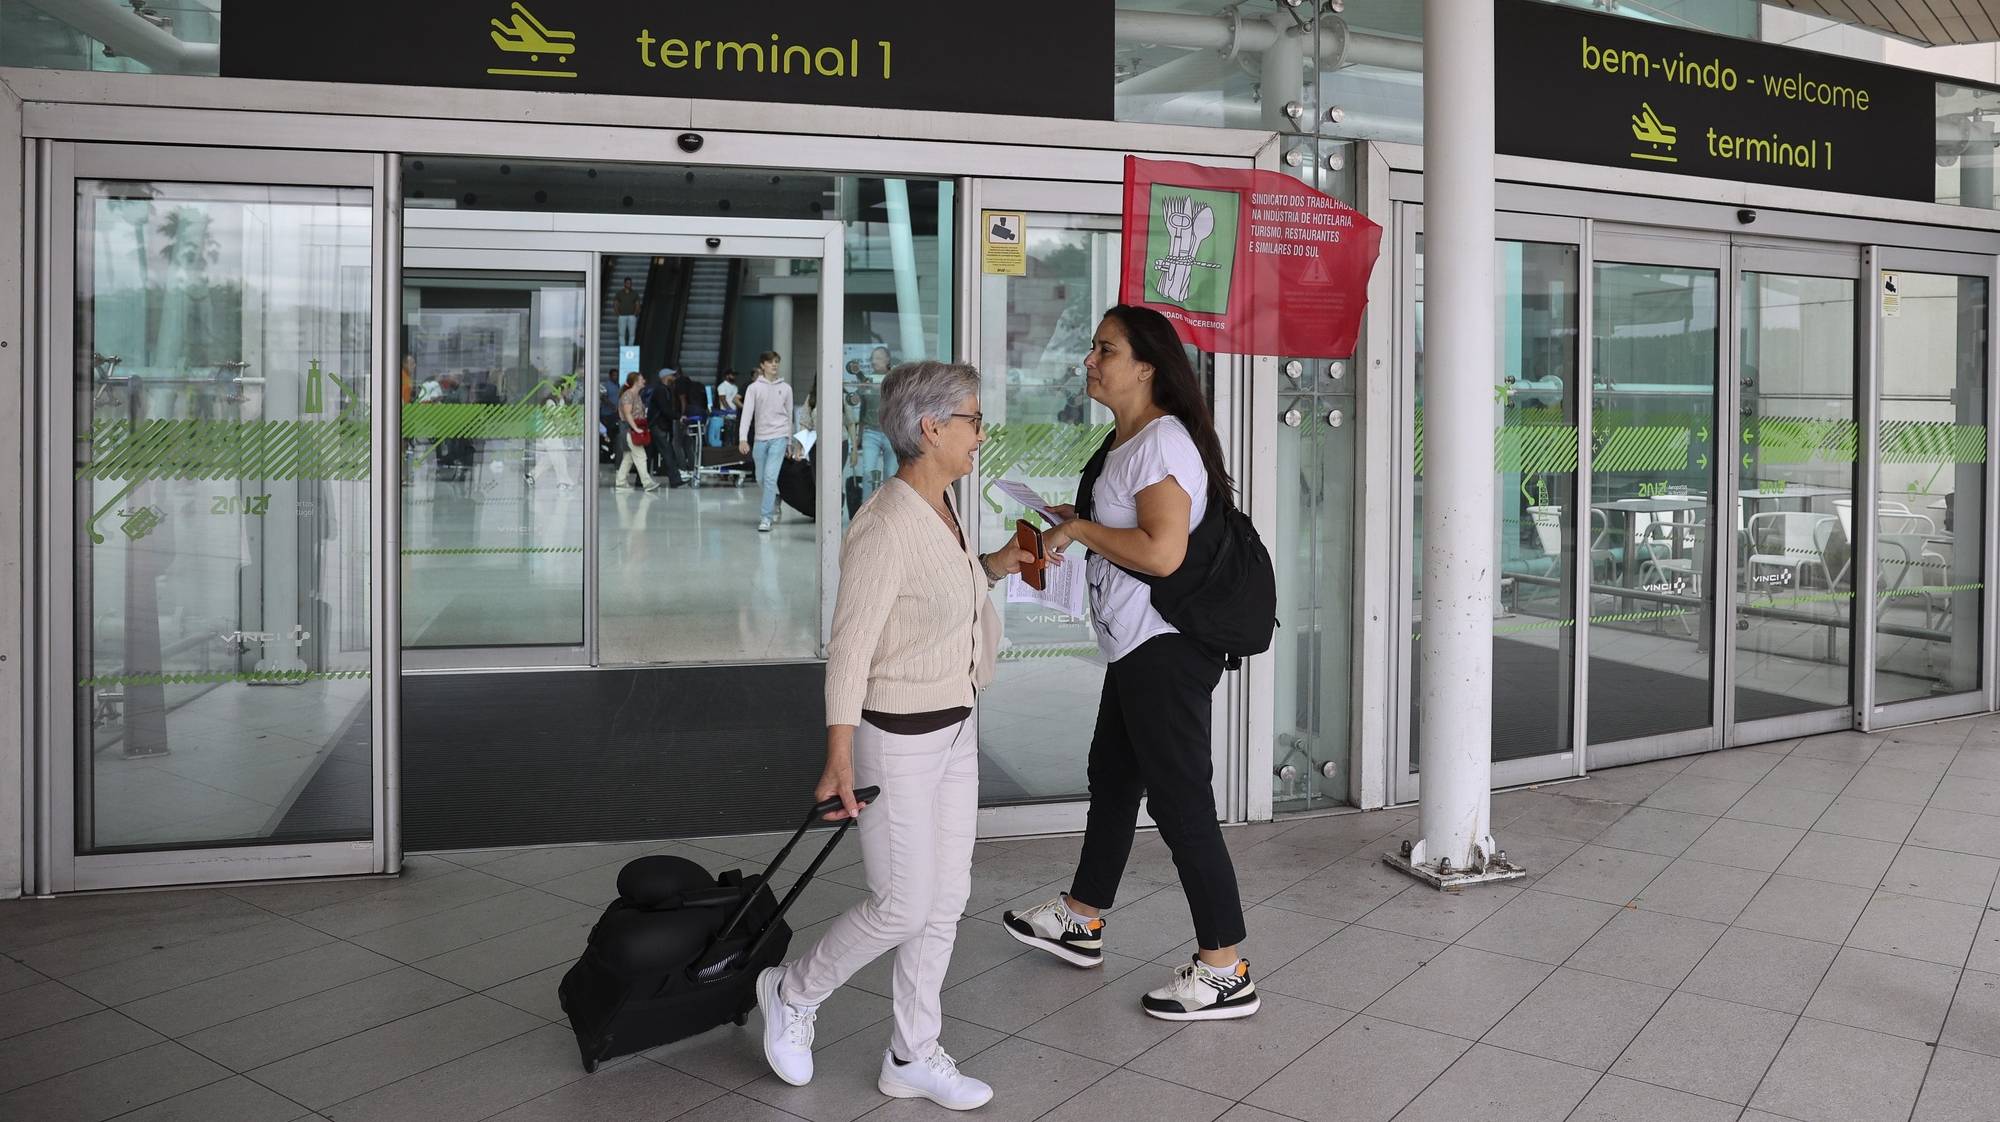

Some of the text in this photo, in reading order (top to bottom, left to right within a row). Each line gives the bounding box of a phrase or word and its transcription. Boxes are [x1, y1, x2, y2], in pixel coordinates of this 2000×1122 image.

[636, 29, 891, 80] terminal 1
[1582, 36, 1738, 91] bem-vindo
[1763, 72, 1870, 111] welcome
[1706, 127, 1832, 170] terminal 1
[1251, 193, 1288, 206] SINDICATO
[1289, 195, 1305, 207] DOS
[1251, 208, 1354, 228] NA INDÚSTRIA DE HOTELARIA,
[1284, 227, 1340, 243] RESTAURANTES
[1248, 241, 1320, 258] E SIMILARES DO SUL
[1752, 574, 1780, 582] VINCI
[1642, 583, 1671, 591] VINCI
[1026, 615, 1075, 623] VINCI
